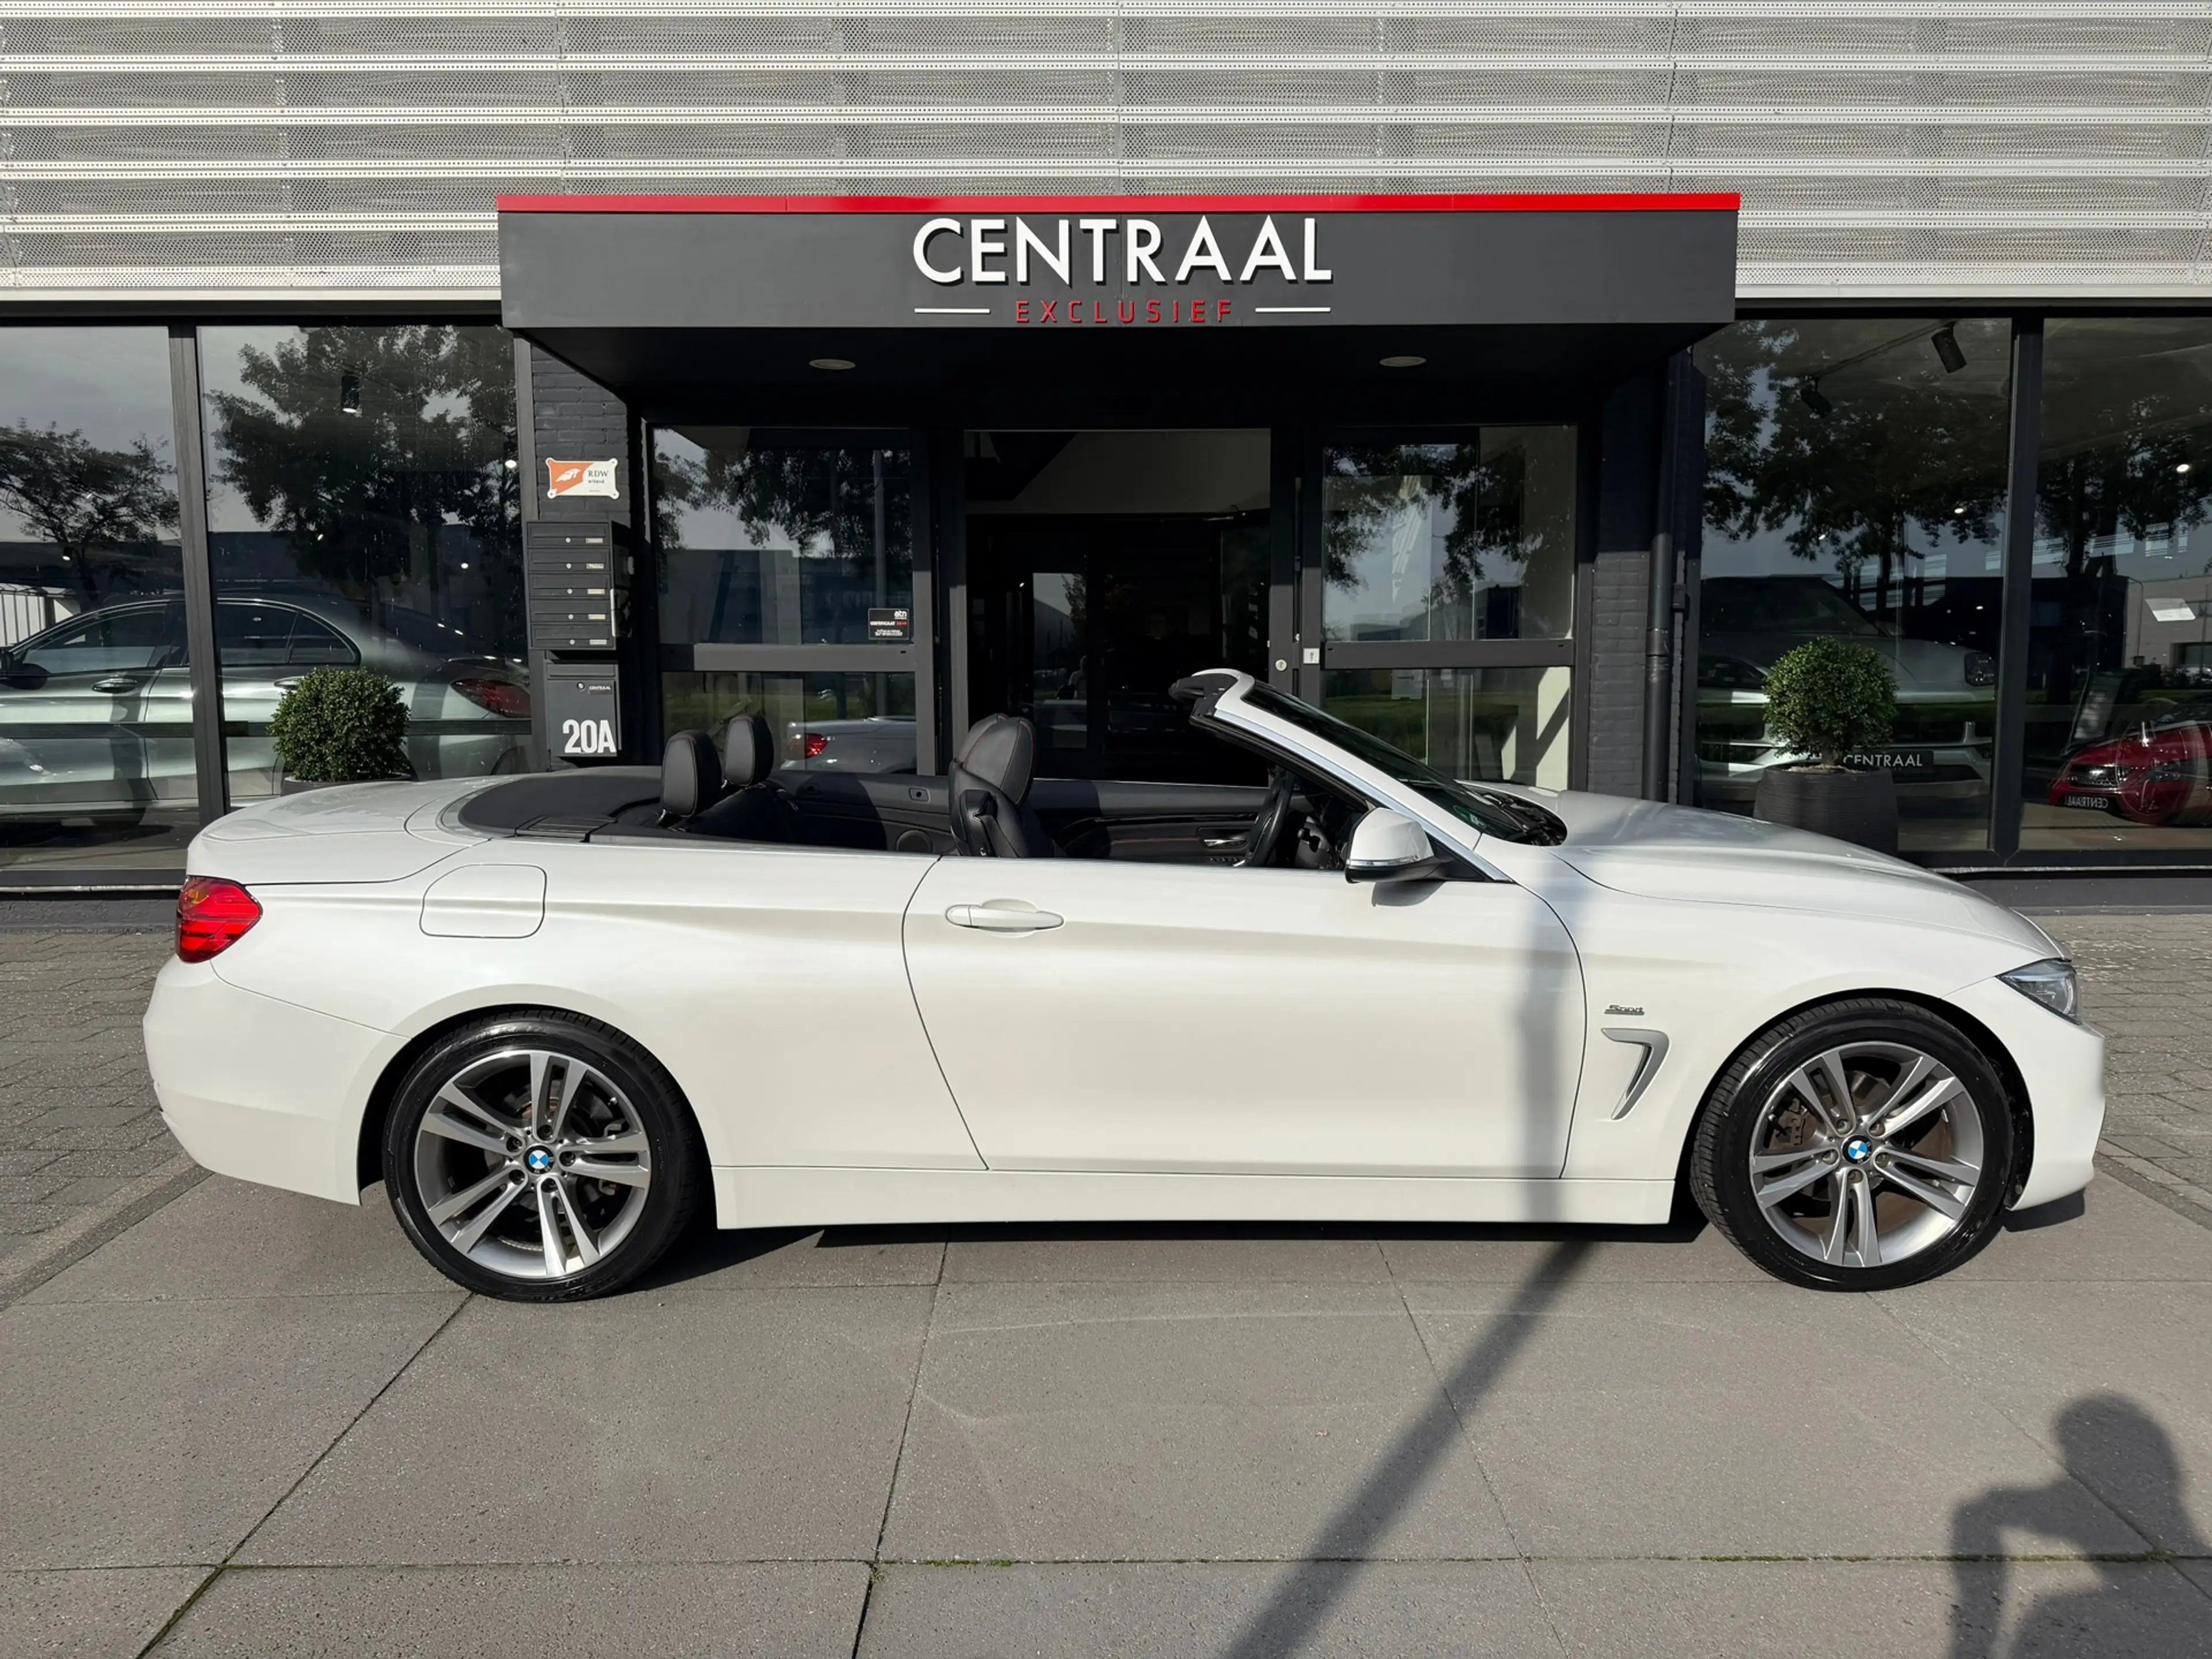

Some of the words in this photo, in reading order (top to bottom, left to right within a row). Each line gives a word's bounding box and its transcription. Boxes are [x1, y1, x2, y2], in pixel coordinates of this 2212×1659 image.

[913, 215, 1332, 285] CENTRAAL
[1016, 300, 1232, 323] EXCLUSIEF
[562, 719, 617, 753] 20A
